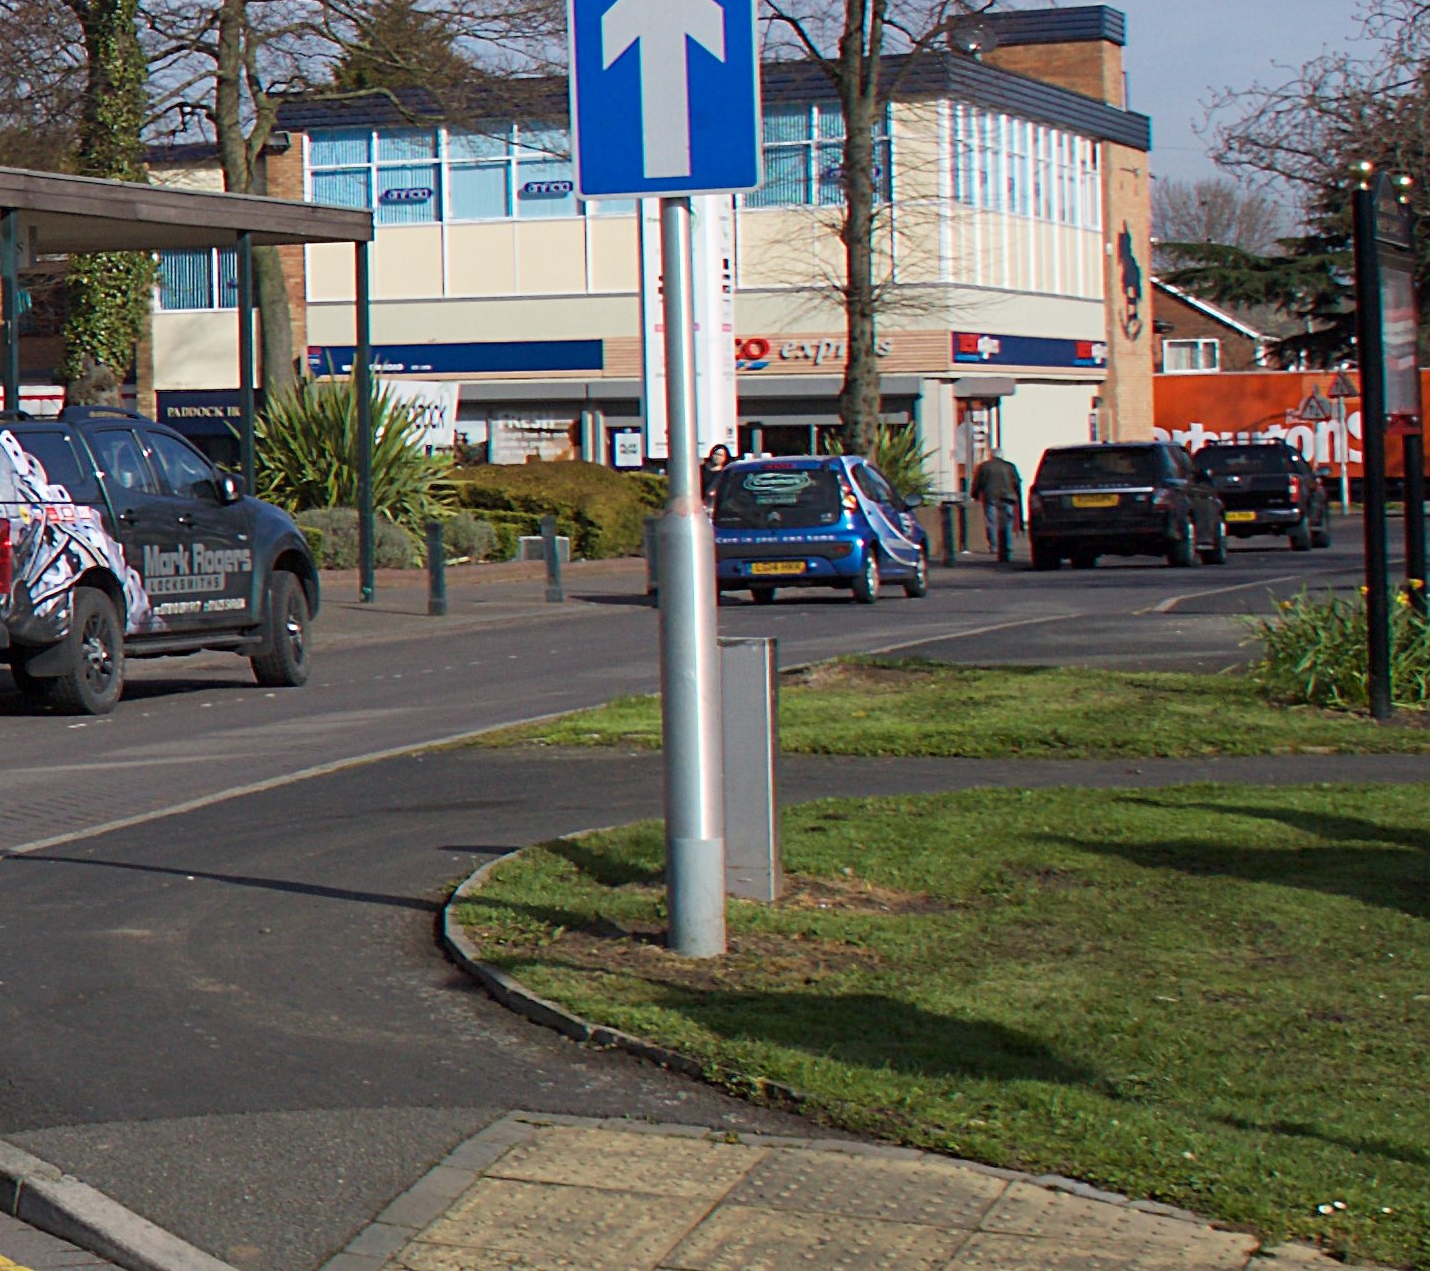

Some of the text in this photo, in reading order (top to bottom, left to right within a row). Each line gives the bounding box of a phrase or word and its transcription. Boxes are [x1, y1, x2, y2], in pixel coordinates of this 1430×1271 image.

[166, 406, 224, 418] PADDOCK
[143, 543, 253, 577] Mark Rogers
[150, 577, 220, 592] LOCKSMITHS
